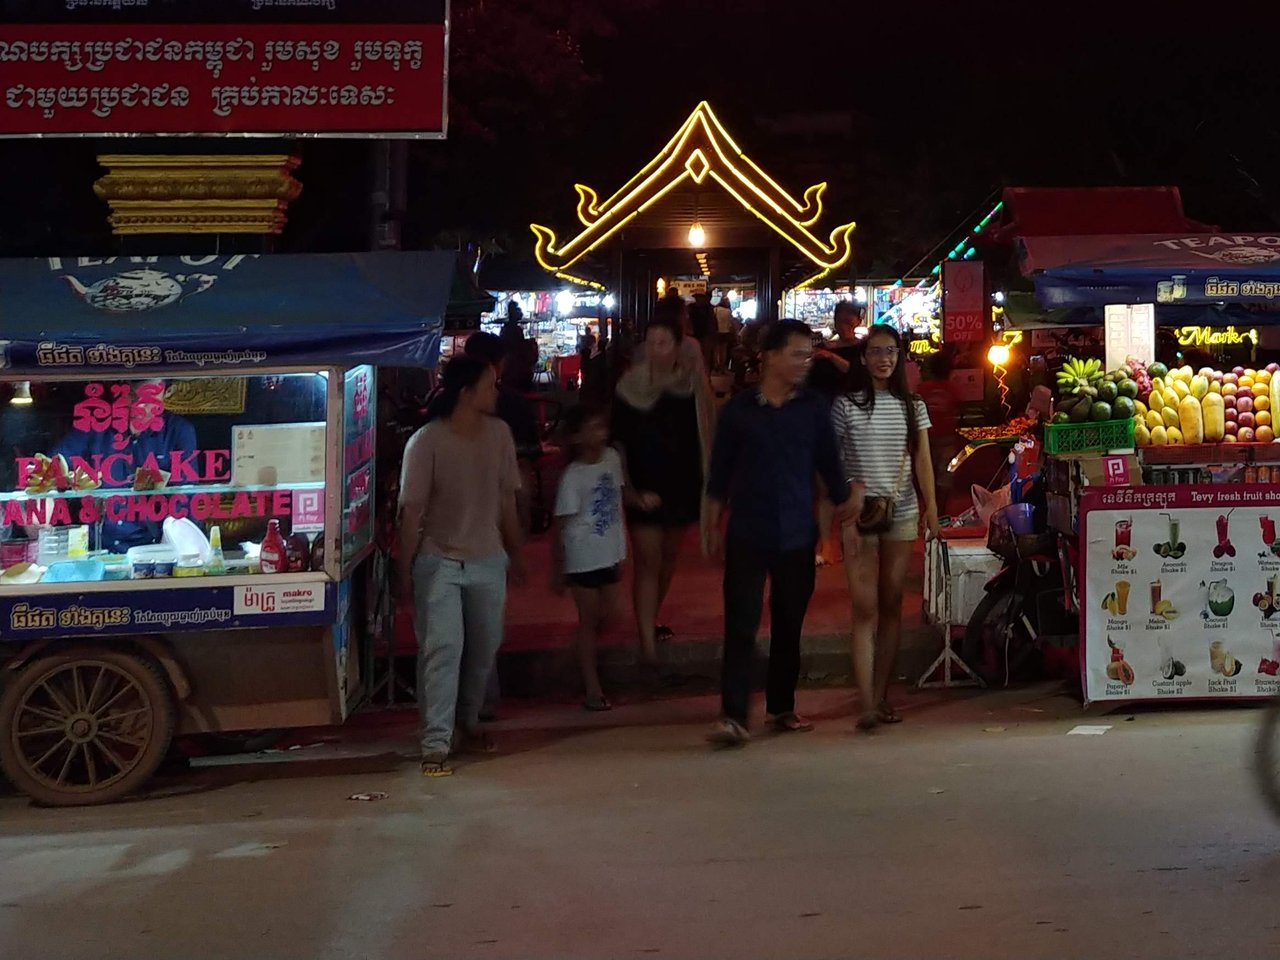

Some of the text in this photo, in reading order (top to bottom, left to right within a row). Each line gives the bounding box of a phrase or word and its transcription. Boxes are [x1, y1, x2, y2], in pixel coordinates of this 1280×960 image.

[261, 39, 341, 72] រួមសុខ
[6, 83, 190, 120] ជាមួយប្រជាជន
[945, 314, 983, 330] 50%
[953, 330, 975, 341] OFF
[15, 449, 231, 490] PANCAKE
[3, 489, 292, 528] ANA & CHOCOLATE
[1191, 492, 1214, 504] Tevy
[1217, 491, 1241, 501] fresh
[1243, 491, 1263, 501] fruit
[282, 590, 313, 598] makro
